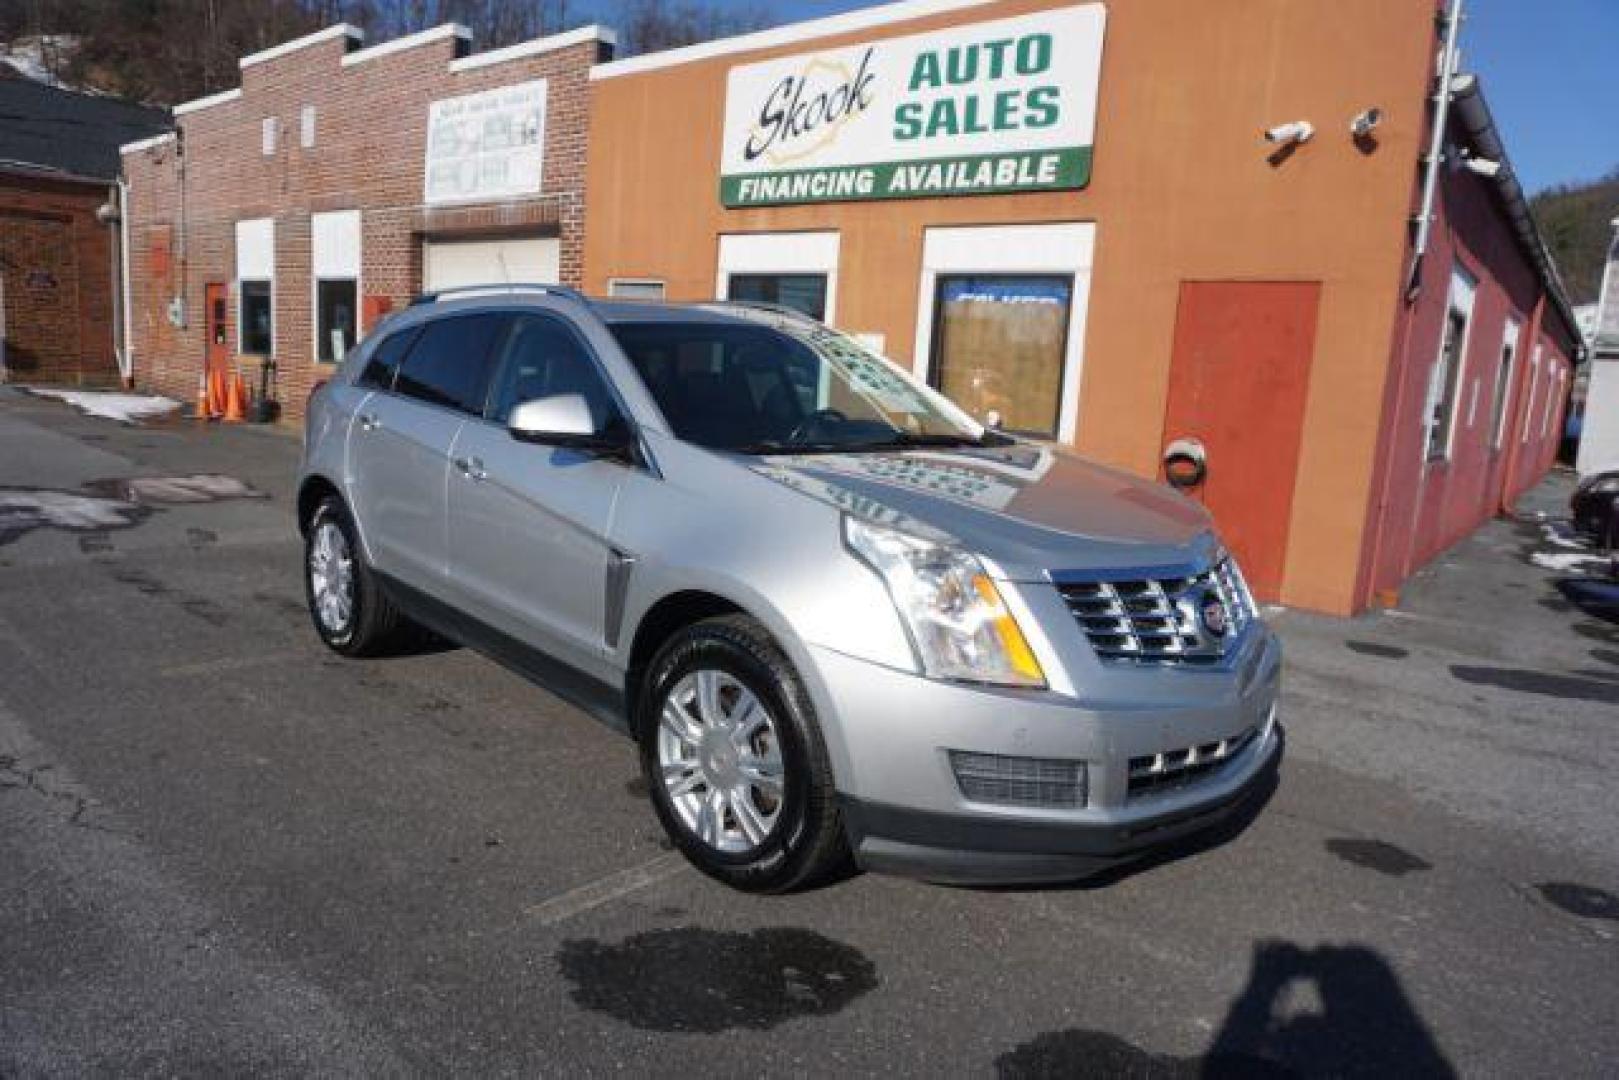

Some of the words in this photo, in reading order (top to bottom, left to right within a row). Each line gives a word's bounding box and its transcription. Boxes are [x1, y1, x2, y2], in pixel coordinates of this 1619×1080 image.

[908, 33, 1053, 92] AUTO
[744, 46, 875, 161] Skook
[893, 85, 1061, 141] SALES
[738, 171, 874, 202] FINANCING
[890, 154, 1059, 193] AVAILABLE
